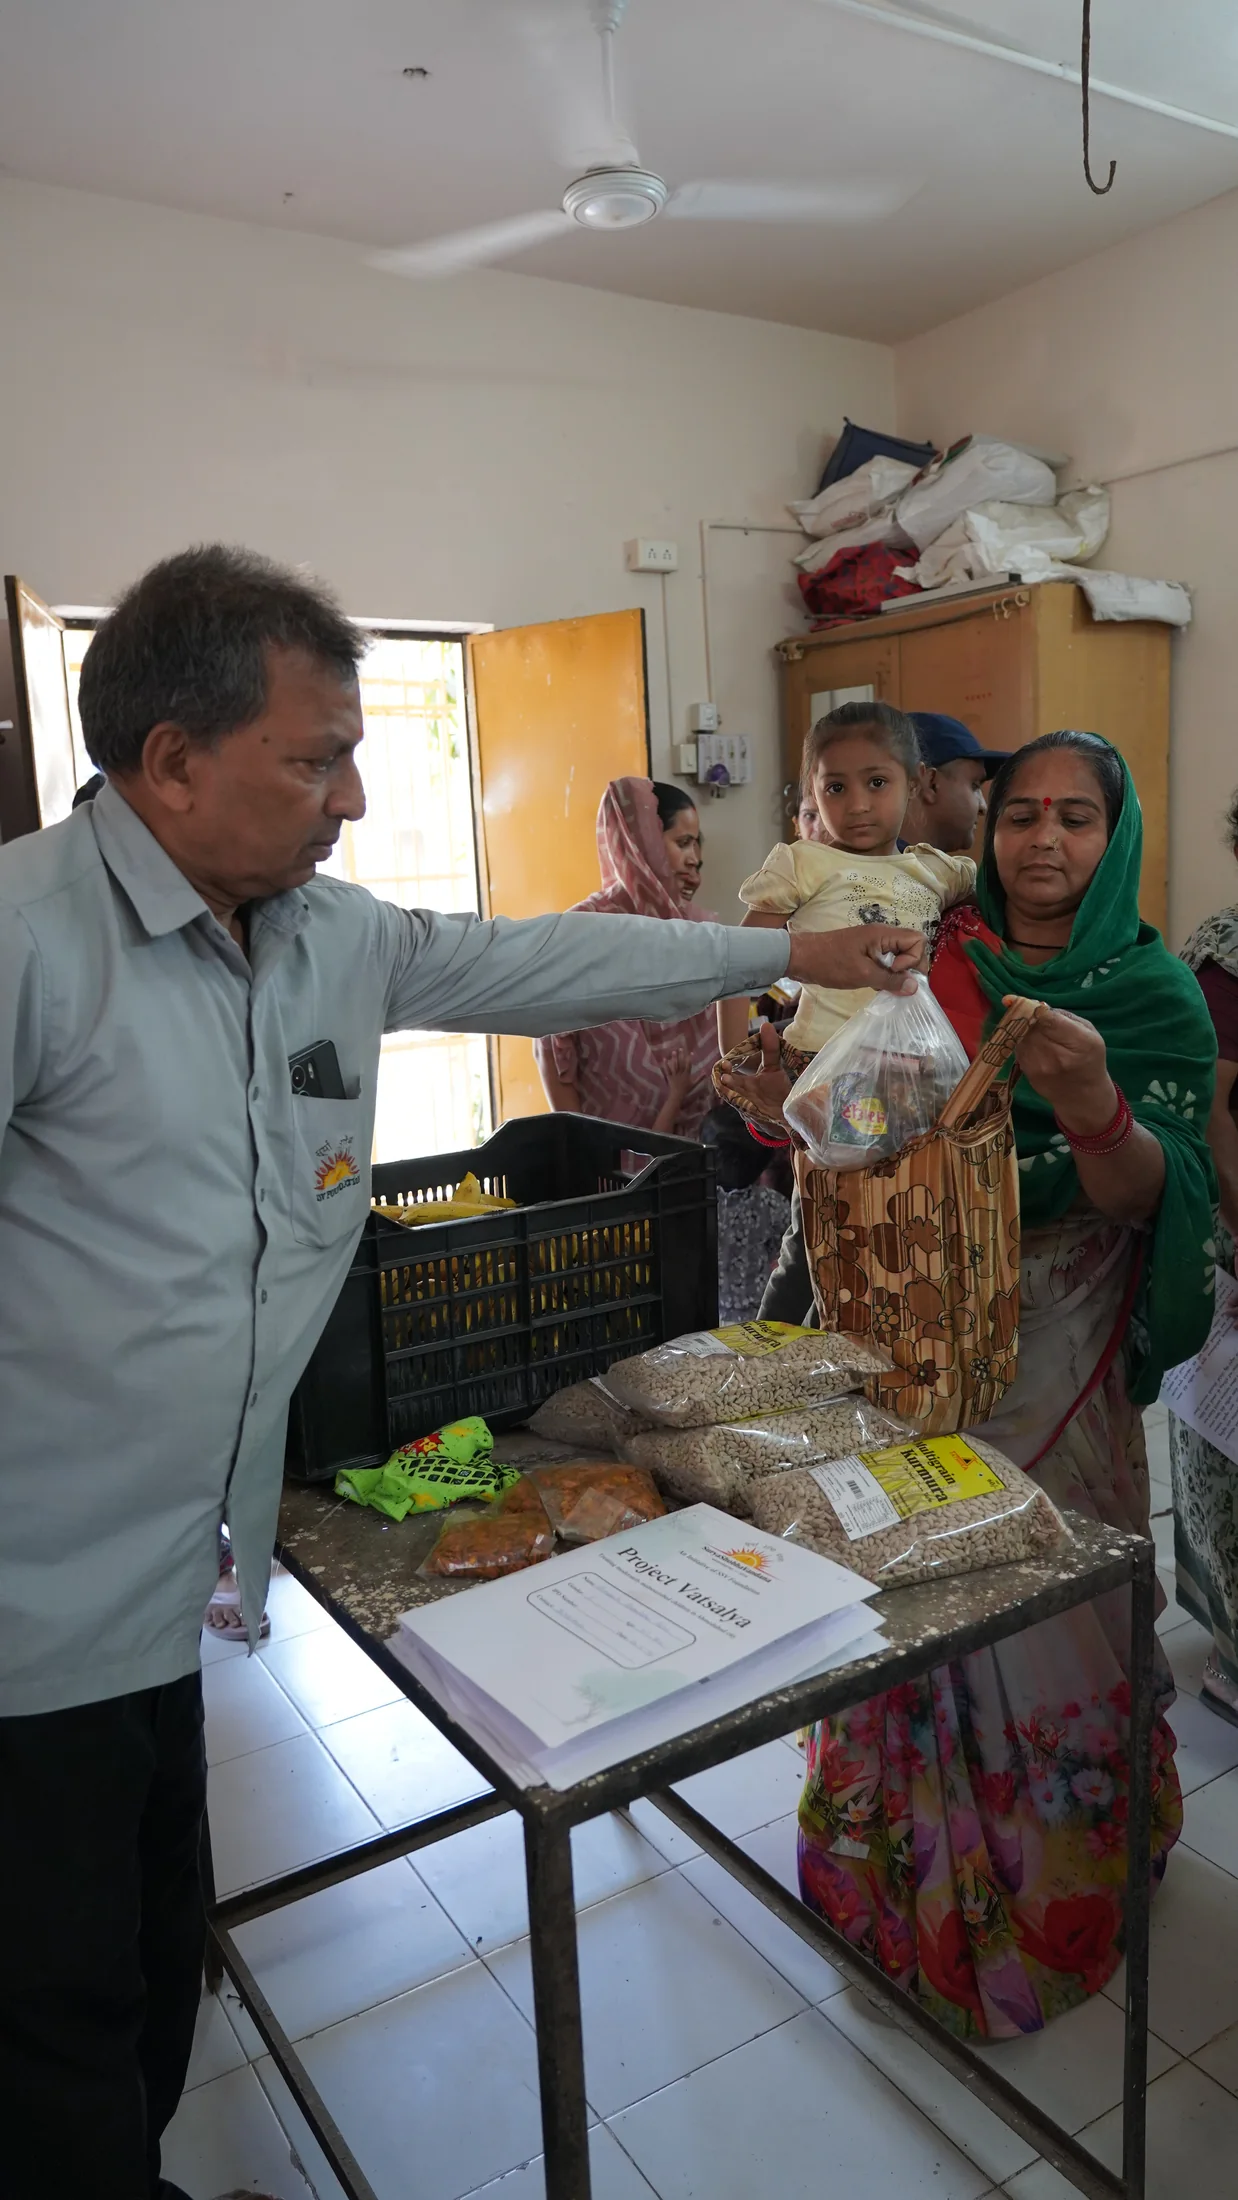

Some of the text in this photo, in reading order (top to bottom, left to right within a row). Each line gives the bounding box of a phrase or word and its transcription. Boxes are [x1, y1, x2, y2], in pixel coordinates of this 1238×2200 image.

[900, 1448, 948, 1503] Kurmura
[617, 1547, 678, 1586] Project
[678, 1582, 752, 1629] Vatsalya
